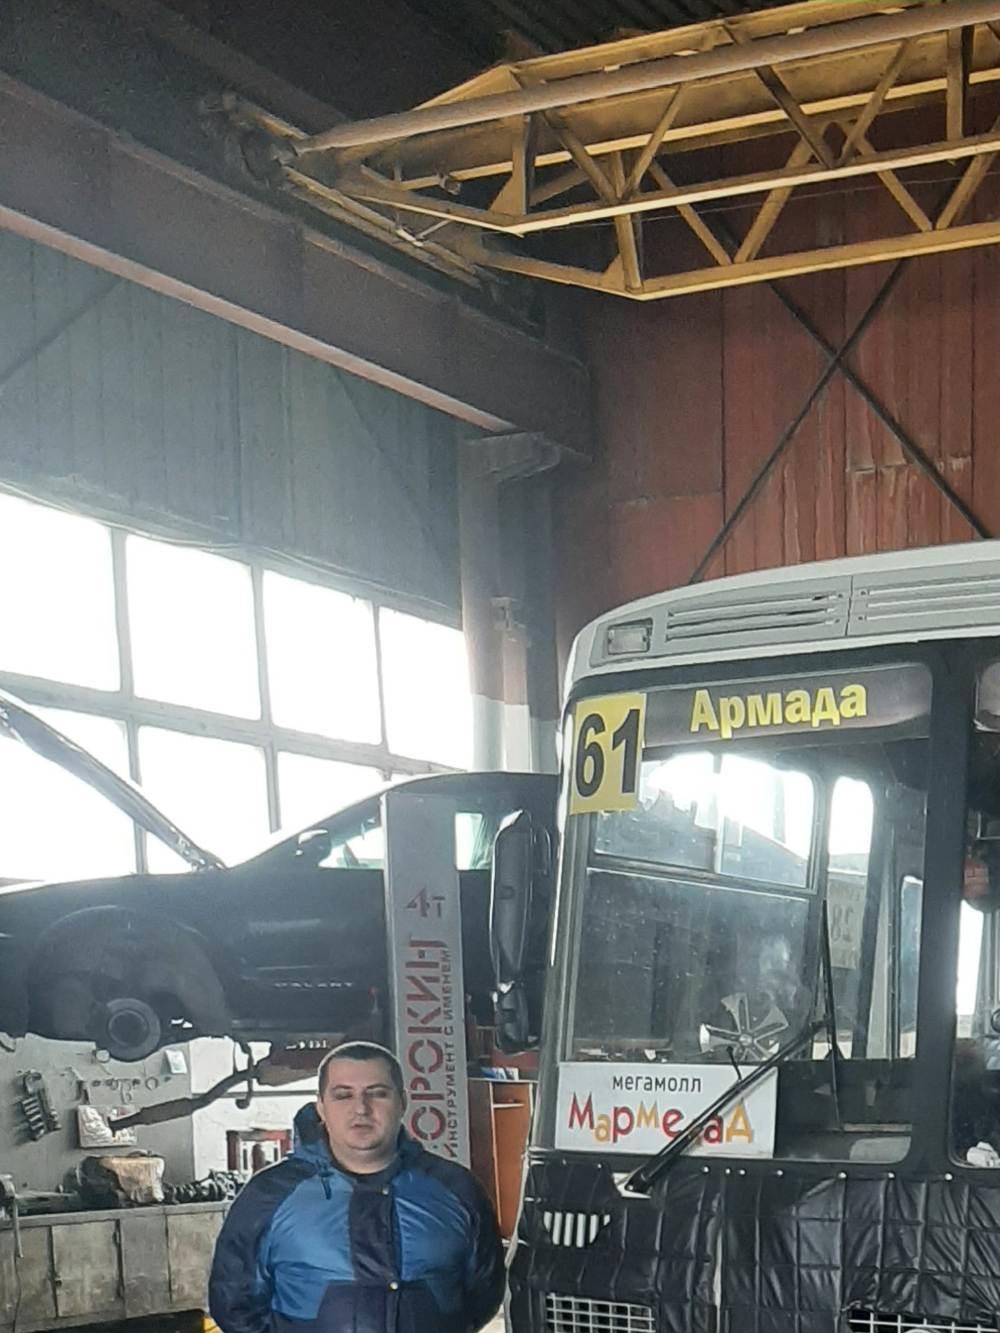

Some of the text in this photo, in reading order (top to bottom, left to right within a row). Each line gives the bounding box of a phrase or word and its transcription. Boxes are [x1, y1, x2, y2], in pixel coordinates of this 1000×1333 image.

[690, 683, 867, 739] Армада
[575, 708, 641, 798] 61
[440, 950, 455, 1021] ИМЕНЕМ
[404, 936, 448, 1149] ОРОКИН
[444, 1042, 458, 1158] ИНСТРУМЕНТ
[612, 1074, 702, 1092] мегамолл
